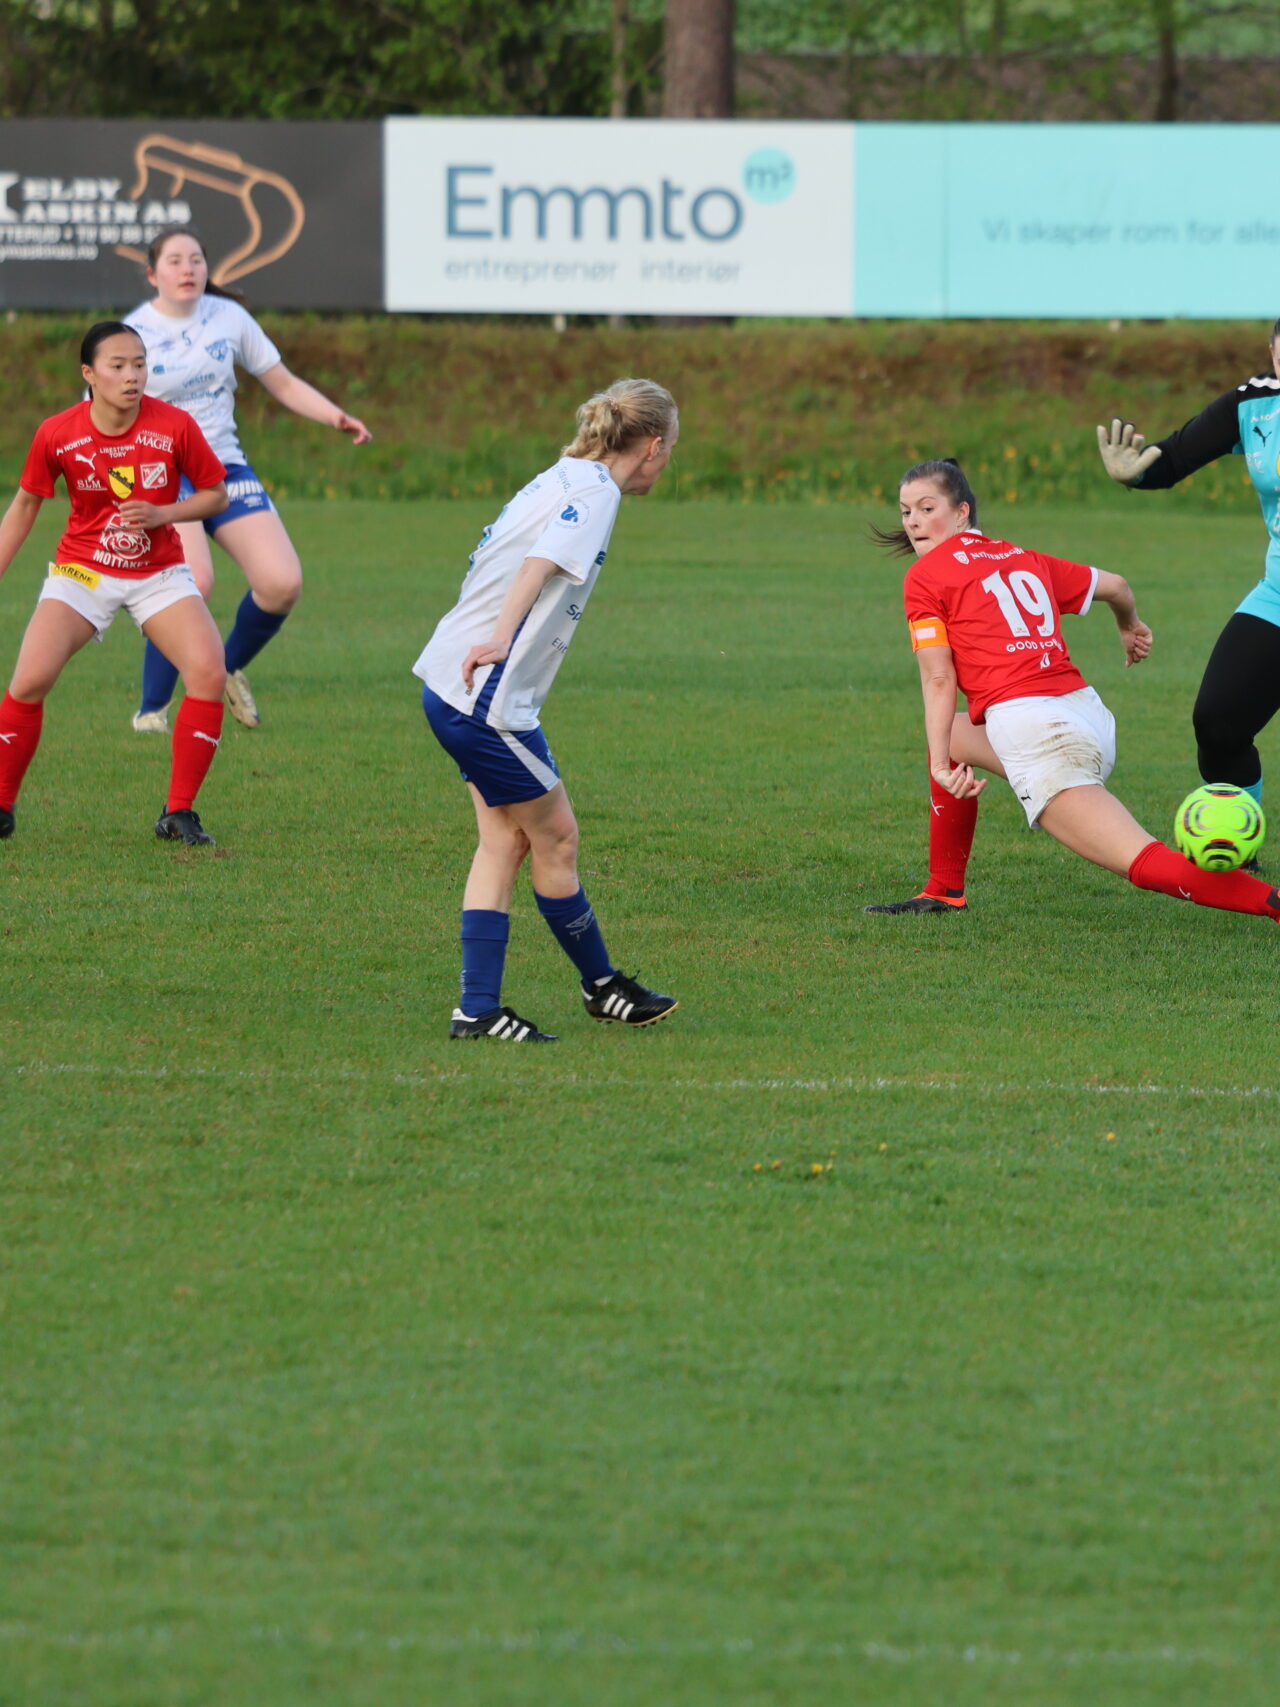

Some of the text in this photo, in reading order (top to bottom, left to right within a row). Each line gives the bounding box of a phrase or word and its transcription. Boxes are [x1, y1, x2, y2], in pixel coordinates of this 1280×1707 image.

[447, 164, 743, 242] Emmto
[1019, 219, 1112, 246] skaper
[1121, 223, 1180, 243] rom
[1185, 218, 1224, 243] for
[982, 570, 1055, 637] 19
[1006, 641, 1038, 652] GOOD
